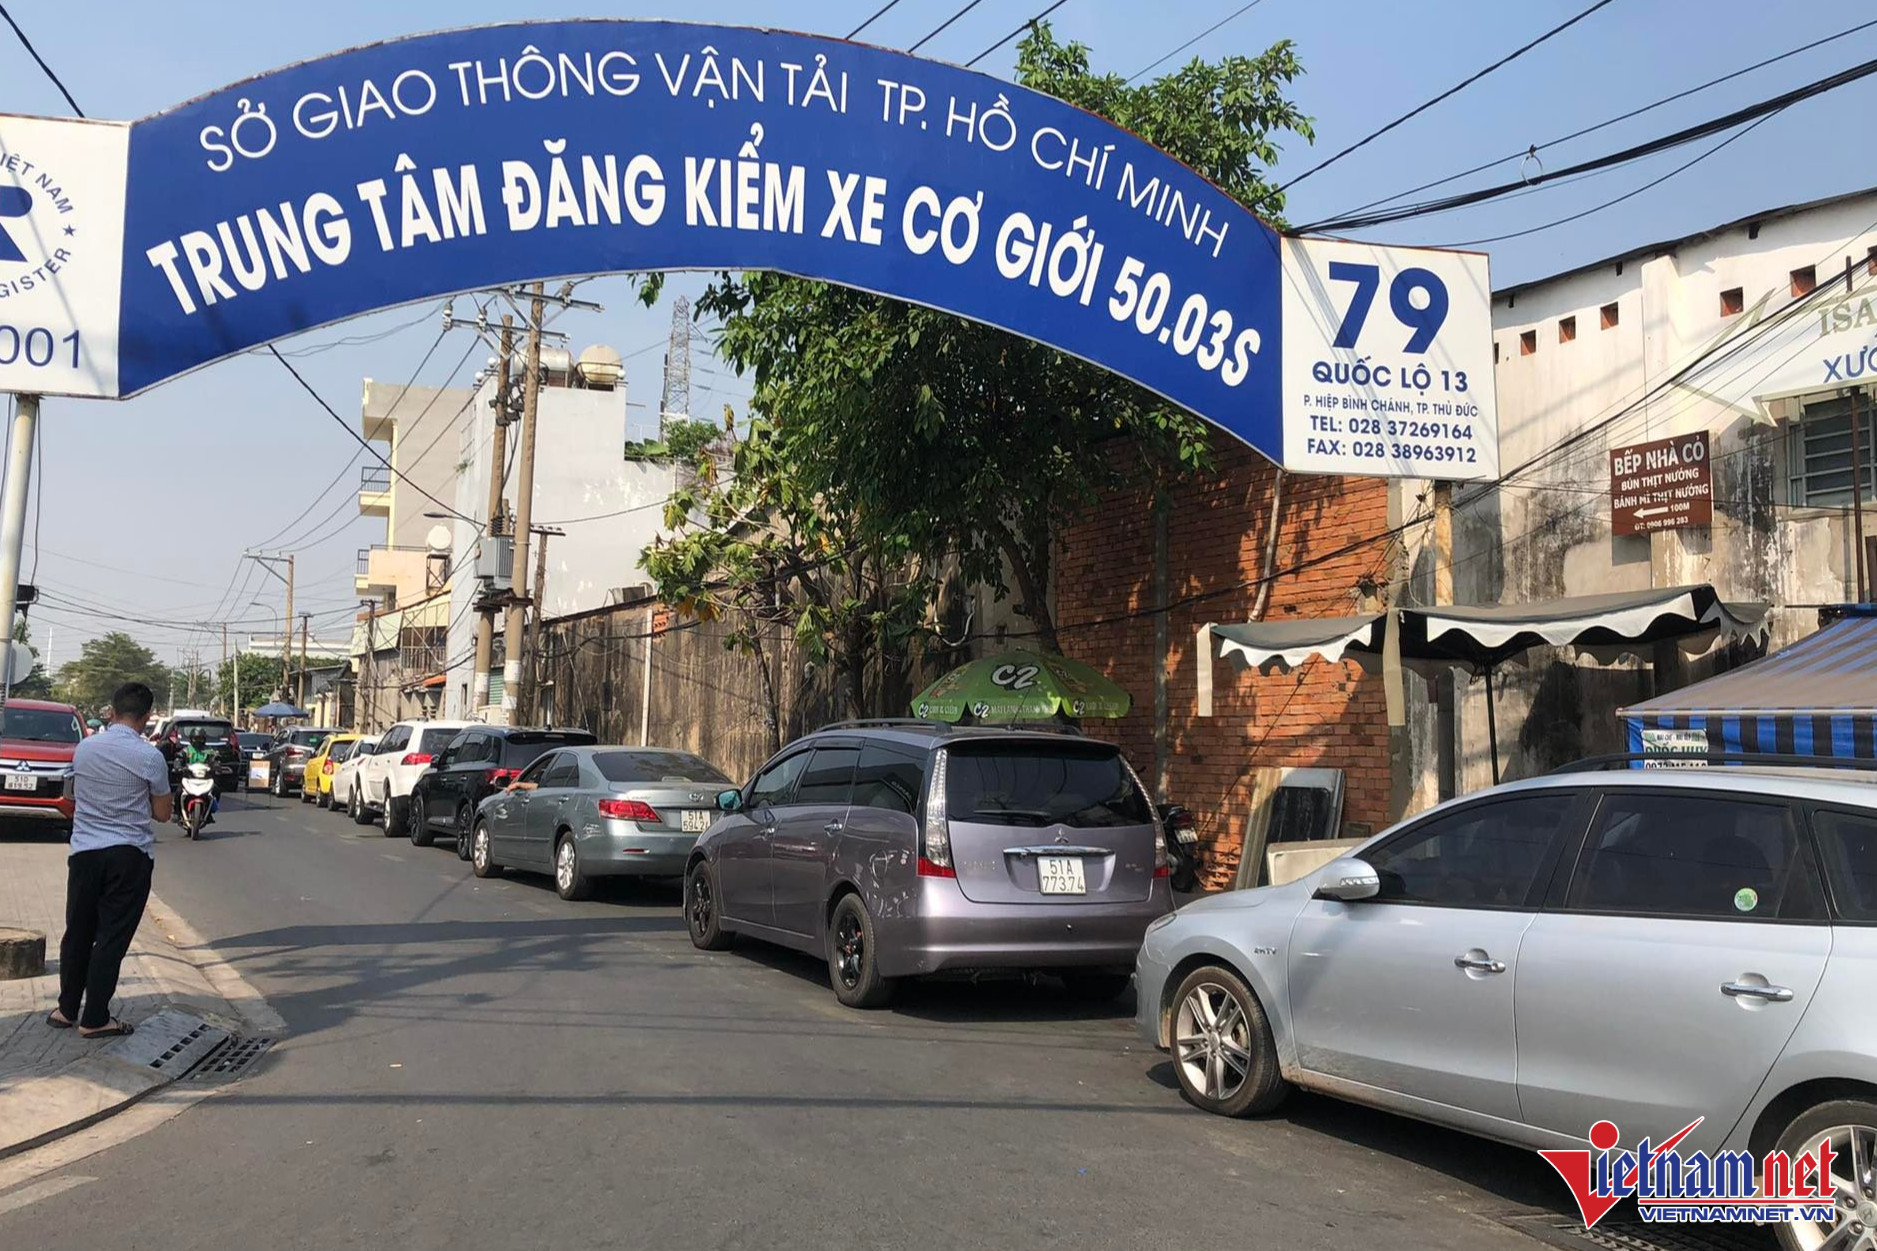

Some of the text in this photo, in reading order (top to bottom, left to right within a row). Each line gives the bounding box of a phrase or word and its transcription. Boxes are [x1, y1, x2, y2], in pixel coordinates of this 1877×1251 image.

[200, 44, 1230, 258] SỞ GIAO THÔNG VẬN TẢI TP. HỒ CHÍ MINH
[35, 173, 74, 214] NAM
[146, 191, 353, 315] TRUNG
[357, 152, 487, 252] TÂM
[501, 137, 667, 232] ĐĂNG
[684, 122, 806, 234] KIỂM
[820, 169, 887, 246] XE
[902, 185, 984, 265] CƠ
[995, 214, 1105, 306] GIỚI
[1108, 256, 1261, 387] 50.03S
[1328, 260, 1449, 354] 79
[1312, 355, 1468, 396] QUỐC LỘ 13
[1304, 395, 1311, 406] P.
[1315, 394, 1339, 411] HIỆP
[1342, 395, 1367, 411] BÌNH
[1417, 403, 1430, 415] TP.
[1432, 400, 1452, 416] THỦ
[1455, 402, 1479, 417] ĐỨC
[1310, 415, 1473, 440] TEL: 028 37269164
[1307, 438, 1477, 463] FAX: 028 38963912
[1614, 449, 1642, 476] BẾP
[1646, 440, 1679, 470] NHÀ
[1641, 474, 1663, 488] THỊT
[1614, 495, 1637, 509] BÁNH
[1670, 502, 1690, 512] 100M
[991, 664, 1040, 690] C2
[918, 703, 929, 718] C2
[973, 702, 990, 718] C2
[1073, 700, 1086, 715] C2
[1050, 859, 1074, 875] 51A
[1042, 875, 1085, 893] 773.74
